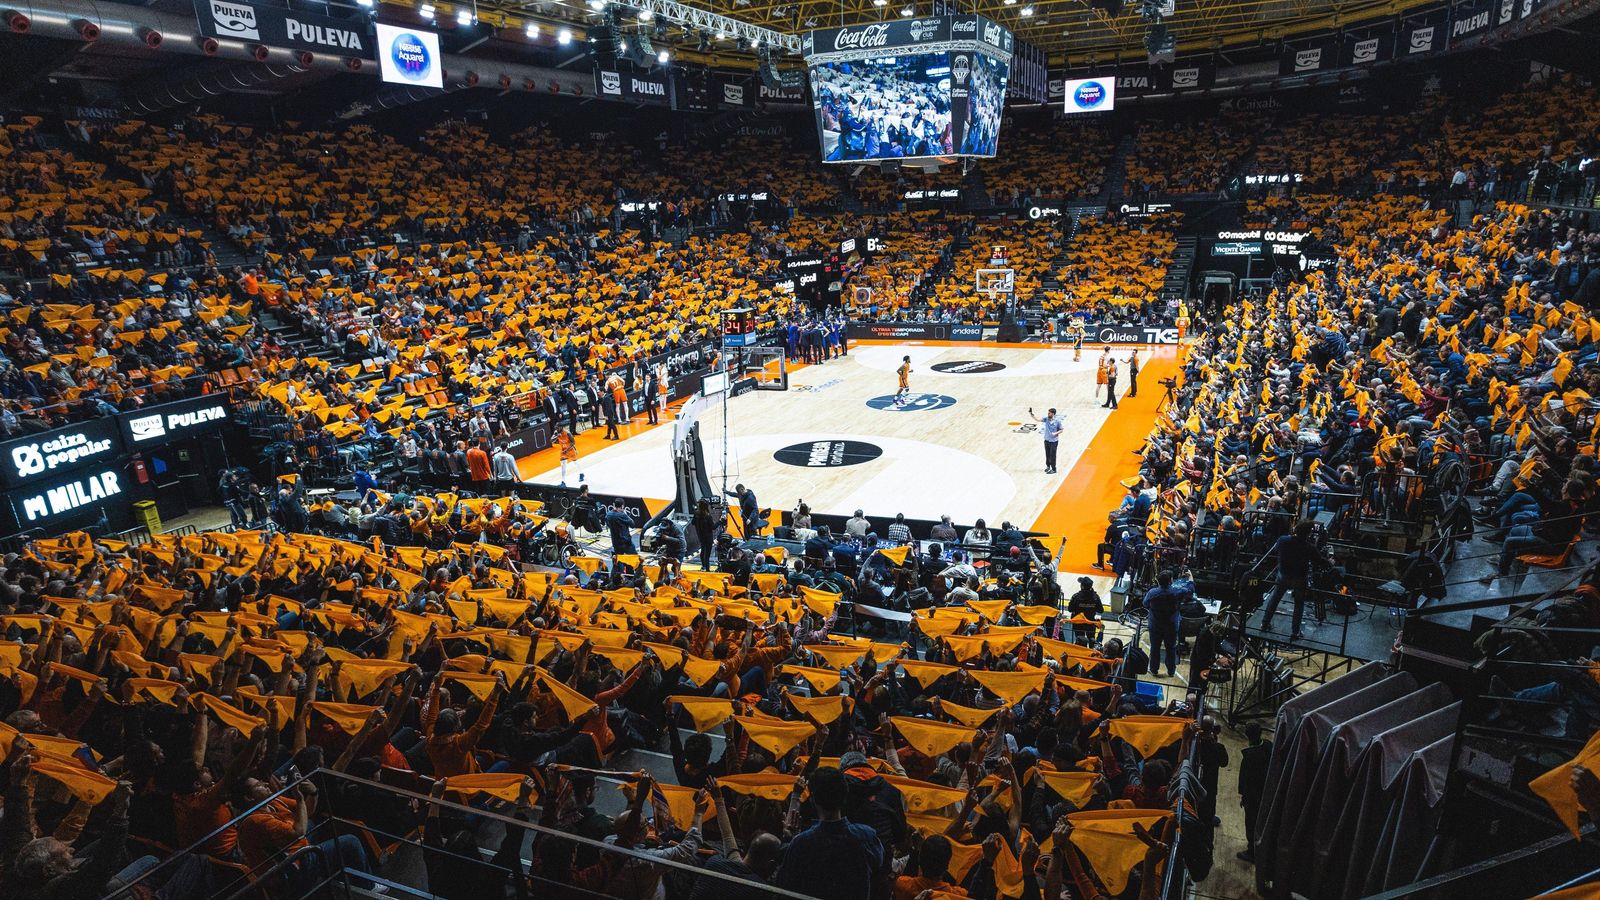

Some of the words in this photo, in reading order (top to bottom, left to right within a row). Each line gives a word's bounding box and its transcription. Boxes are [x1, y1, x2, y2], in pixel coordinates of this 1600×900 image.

[214, 5, 253, 20] PULEVA
[952, 20, 976, 32] Coca-Cola
[1453, 11, 1488, 37] PULEVA
[285, 18, 362, 50] PULEVA
[834, 24, 890, 50] Coca-Cola
[1413, 31, 1432, 40] PULEVA
[1356, 42, 1377, 51] PULEVA
[1297, 52, 1319, 60] PULEVA
[603, 74, 619, 82] PULEVA
[1117, 76, 1148, 89] LEVA
[631, 78, 665, 95] PULEVA
[725, 321, 740, 334] 24
[745, 320, 754, 333] 24
[952, 327, 980, 335] endesa
[1106, 332, 1138, 342] Midea
[1143, 328, 1179, 344] TKE
[133, 418, 160, 428] PULEVA
[168, 406, 226, 429] PULEVA
[42, 433, 88, 453] caixa
[46, 439, 111, 469] popular
[47, 471, 121, 515] MILAR
